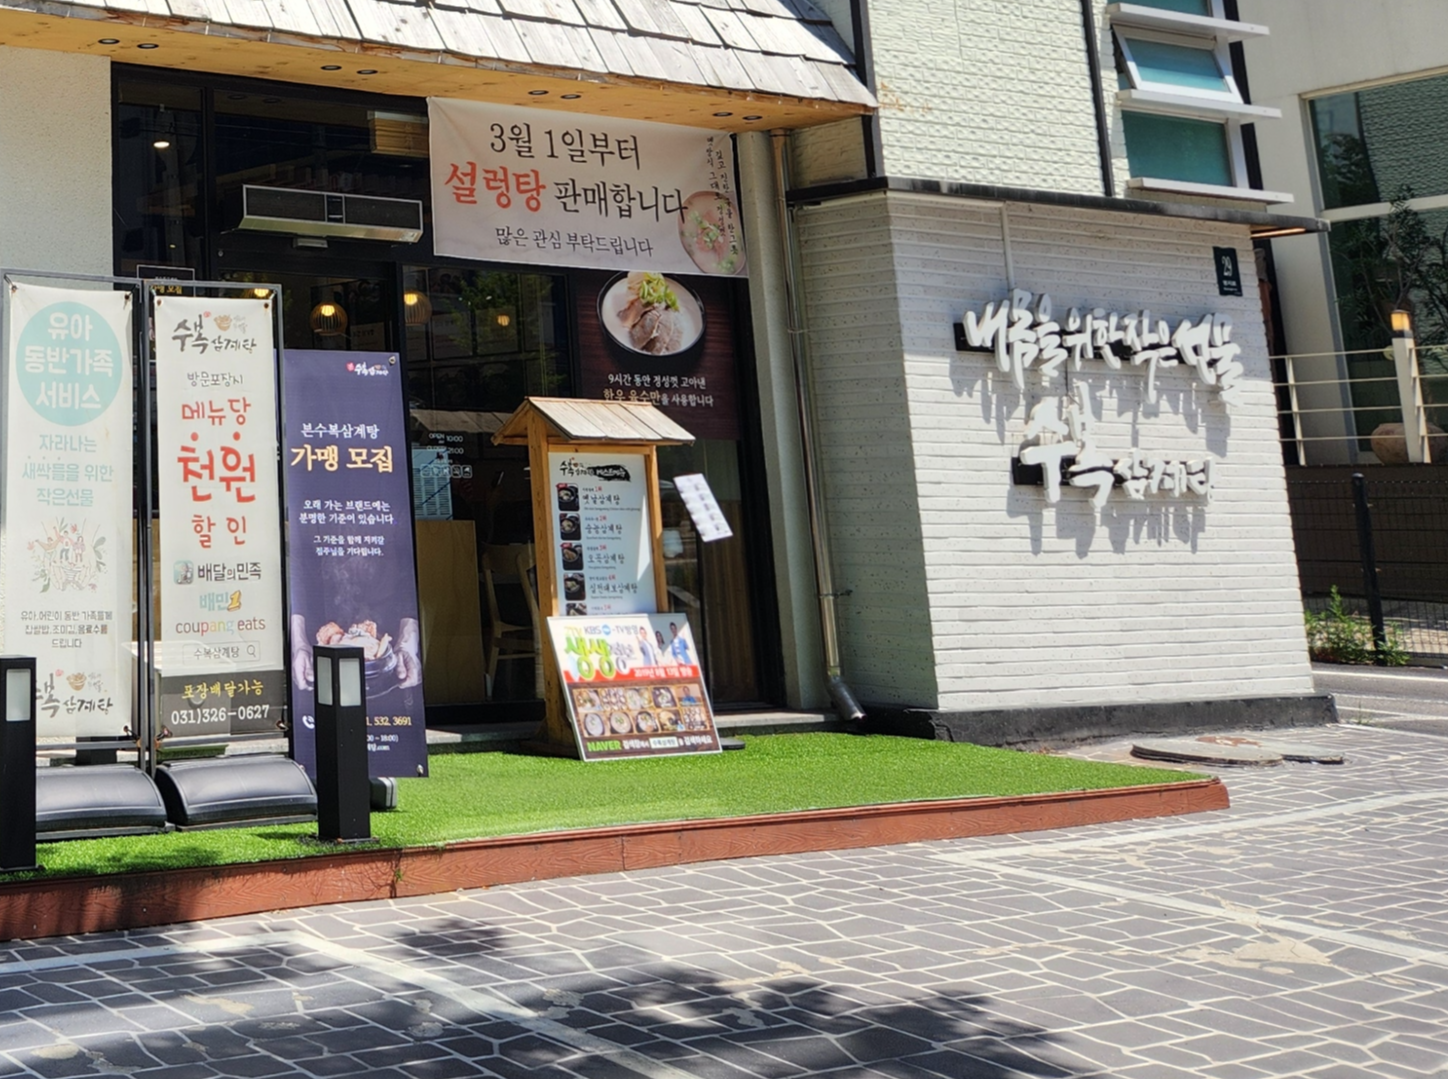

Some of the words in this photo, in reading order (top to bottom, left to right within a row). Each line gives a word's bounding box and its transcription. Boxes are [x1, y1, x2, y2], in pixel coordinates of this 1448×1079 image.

[490, 122, 536, 159] 3월
[544, 128, 642, 171] 1일부터
[445, 161, 547, 213] 설렁탕
[553, 178, 689, 223] 판매합니다
[496, 226, 529, 246] 많은
[532, 229, 562, 249] 관심
[565, 232, 654, 258] 부탁드립니다
[1221, 255, 1232, 276] 29
[47, 311, 93, 341] 유아
[172, 314, 209, 354] 수복
[211, 336, 257, 354] 삼계탕
[24, 345, 114, 377] 동반가족
[187, 371, 243, 387] 방문포장시
[608, 373, 631, 386] 9시간
[633, 374, 651, 387] 동안
[680, 376, 706, 390] 고아낸
[35, 381, 101, 410] 서비스
[671, 394, 714, 407] 사용합니다
[181, 397, 251, 426] 메뉴당
[301, 423, 380, 439] 본수복삼계탕
[38, 434, 97, 453] 자라나는
[290, 444, 340, 471] 가맹
[346, 445, 394, 473] 모집
[22, 462, 80, 481] 새싹들을
[84, 464, 114, 482] 위한
[177, 444, 256, 503] 천원
[37, 488, 94, 507] 작은선물
[303, 499, 321, 510] 오래
[324, 499, 343, 511] 가는
[346, 500, 390, 512] 브랜드에는
[299, 512, 326, 524] 분명한
[329, 513, 355, 524] 기준이
[191, 514, 247, 549] 할인
[197, 562, 261, 582] 배달의민족
[64, 610, 80, 621] 동반
[175, 620, 235, 637] coupang
[237, 617, 266, 632] eats
[584, 625, 602, 635] KBS
[51, 638, 83, 648] 드립니다
[193, 646, 240, 659] 수복삼계탕
[36, 673, 61, 718] 복
[64, 696, 113, 716] 삼계탕
[171, 704, 270, 725] 031)326-0627
[587, 740, 621, 752] NAVER
